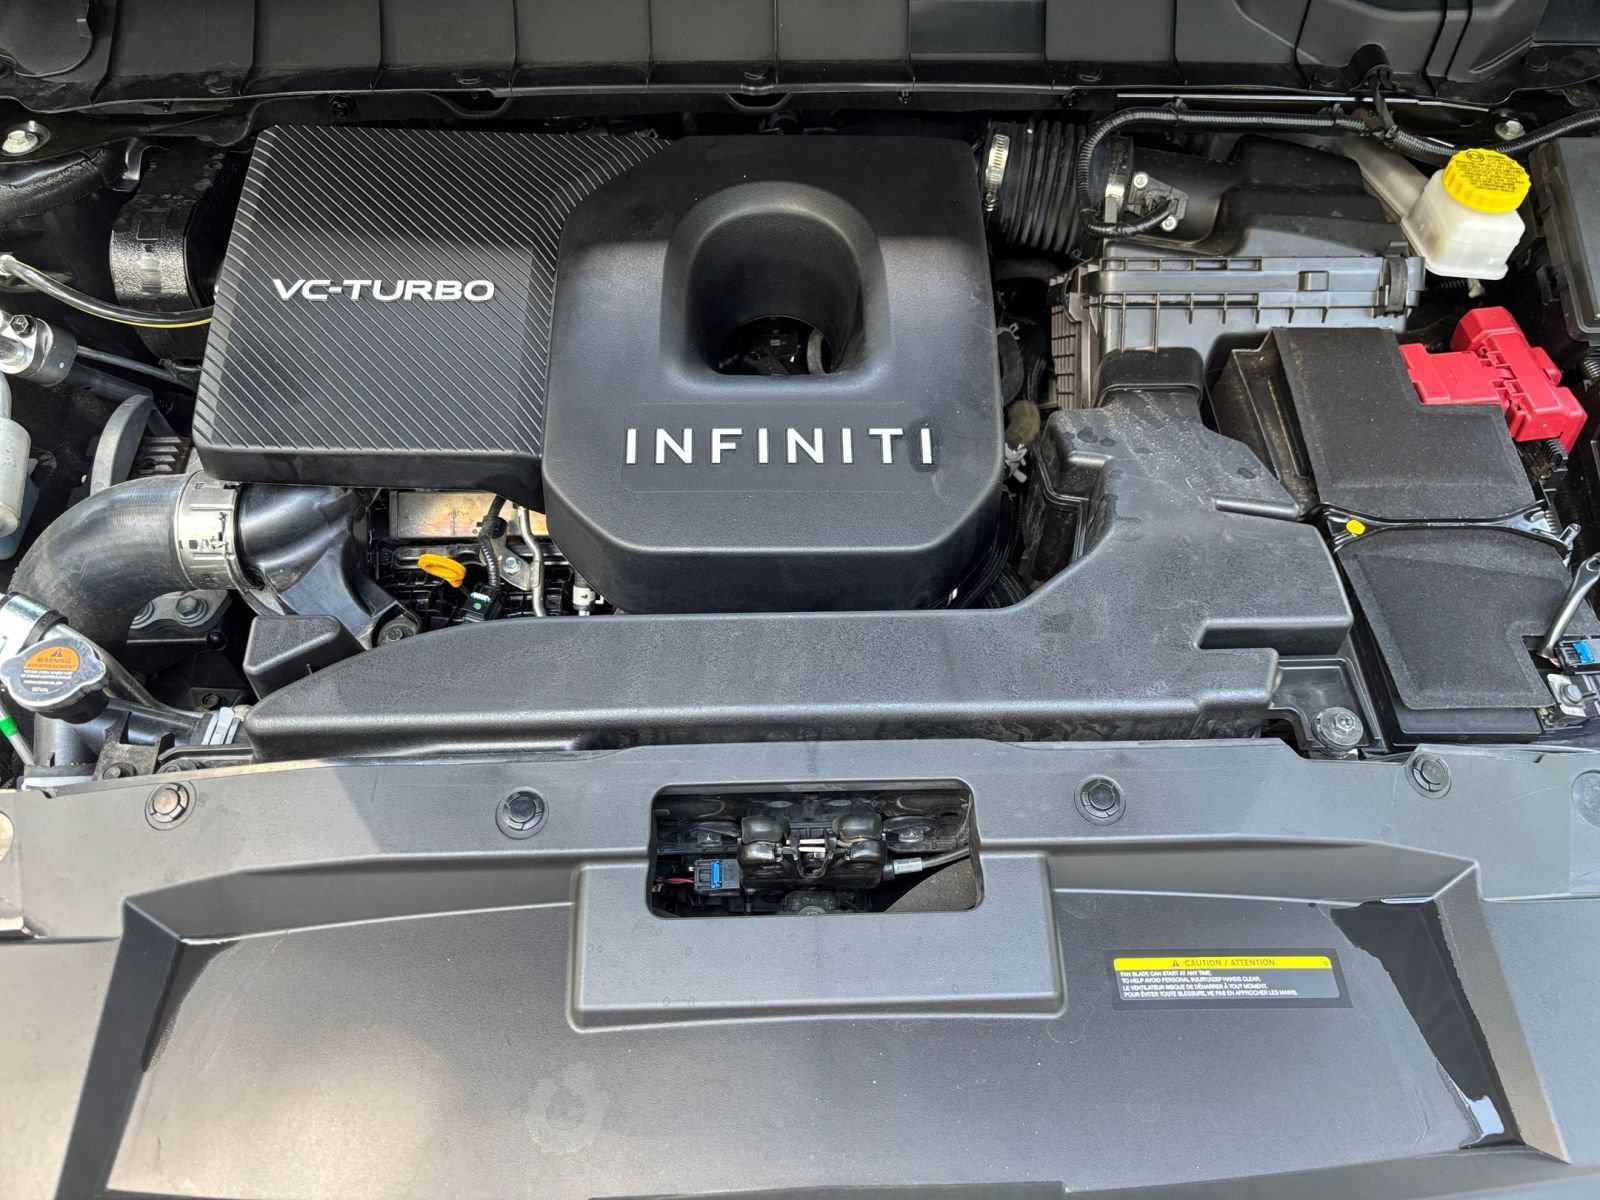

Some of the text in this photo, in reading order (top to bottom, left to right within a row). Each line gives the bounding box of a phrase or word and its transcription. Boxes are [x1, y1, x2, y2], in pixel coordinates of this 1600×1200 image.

[272, 278, 495, 302] VC-TURBO
[625, 427, 933, 465] INFINITI
[1230, 959, 1275, 967] ATTENTION
